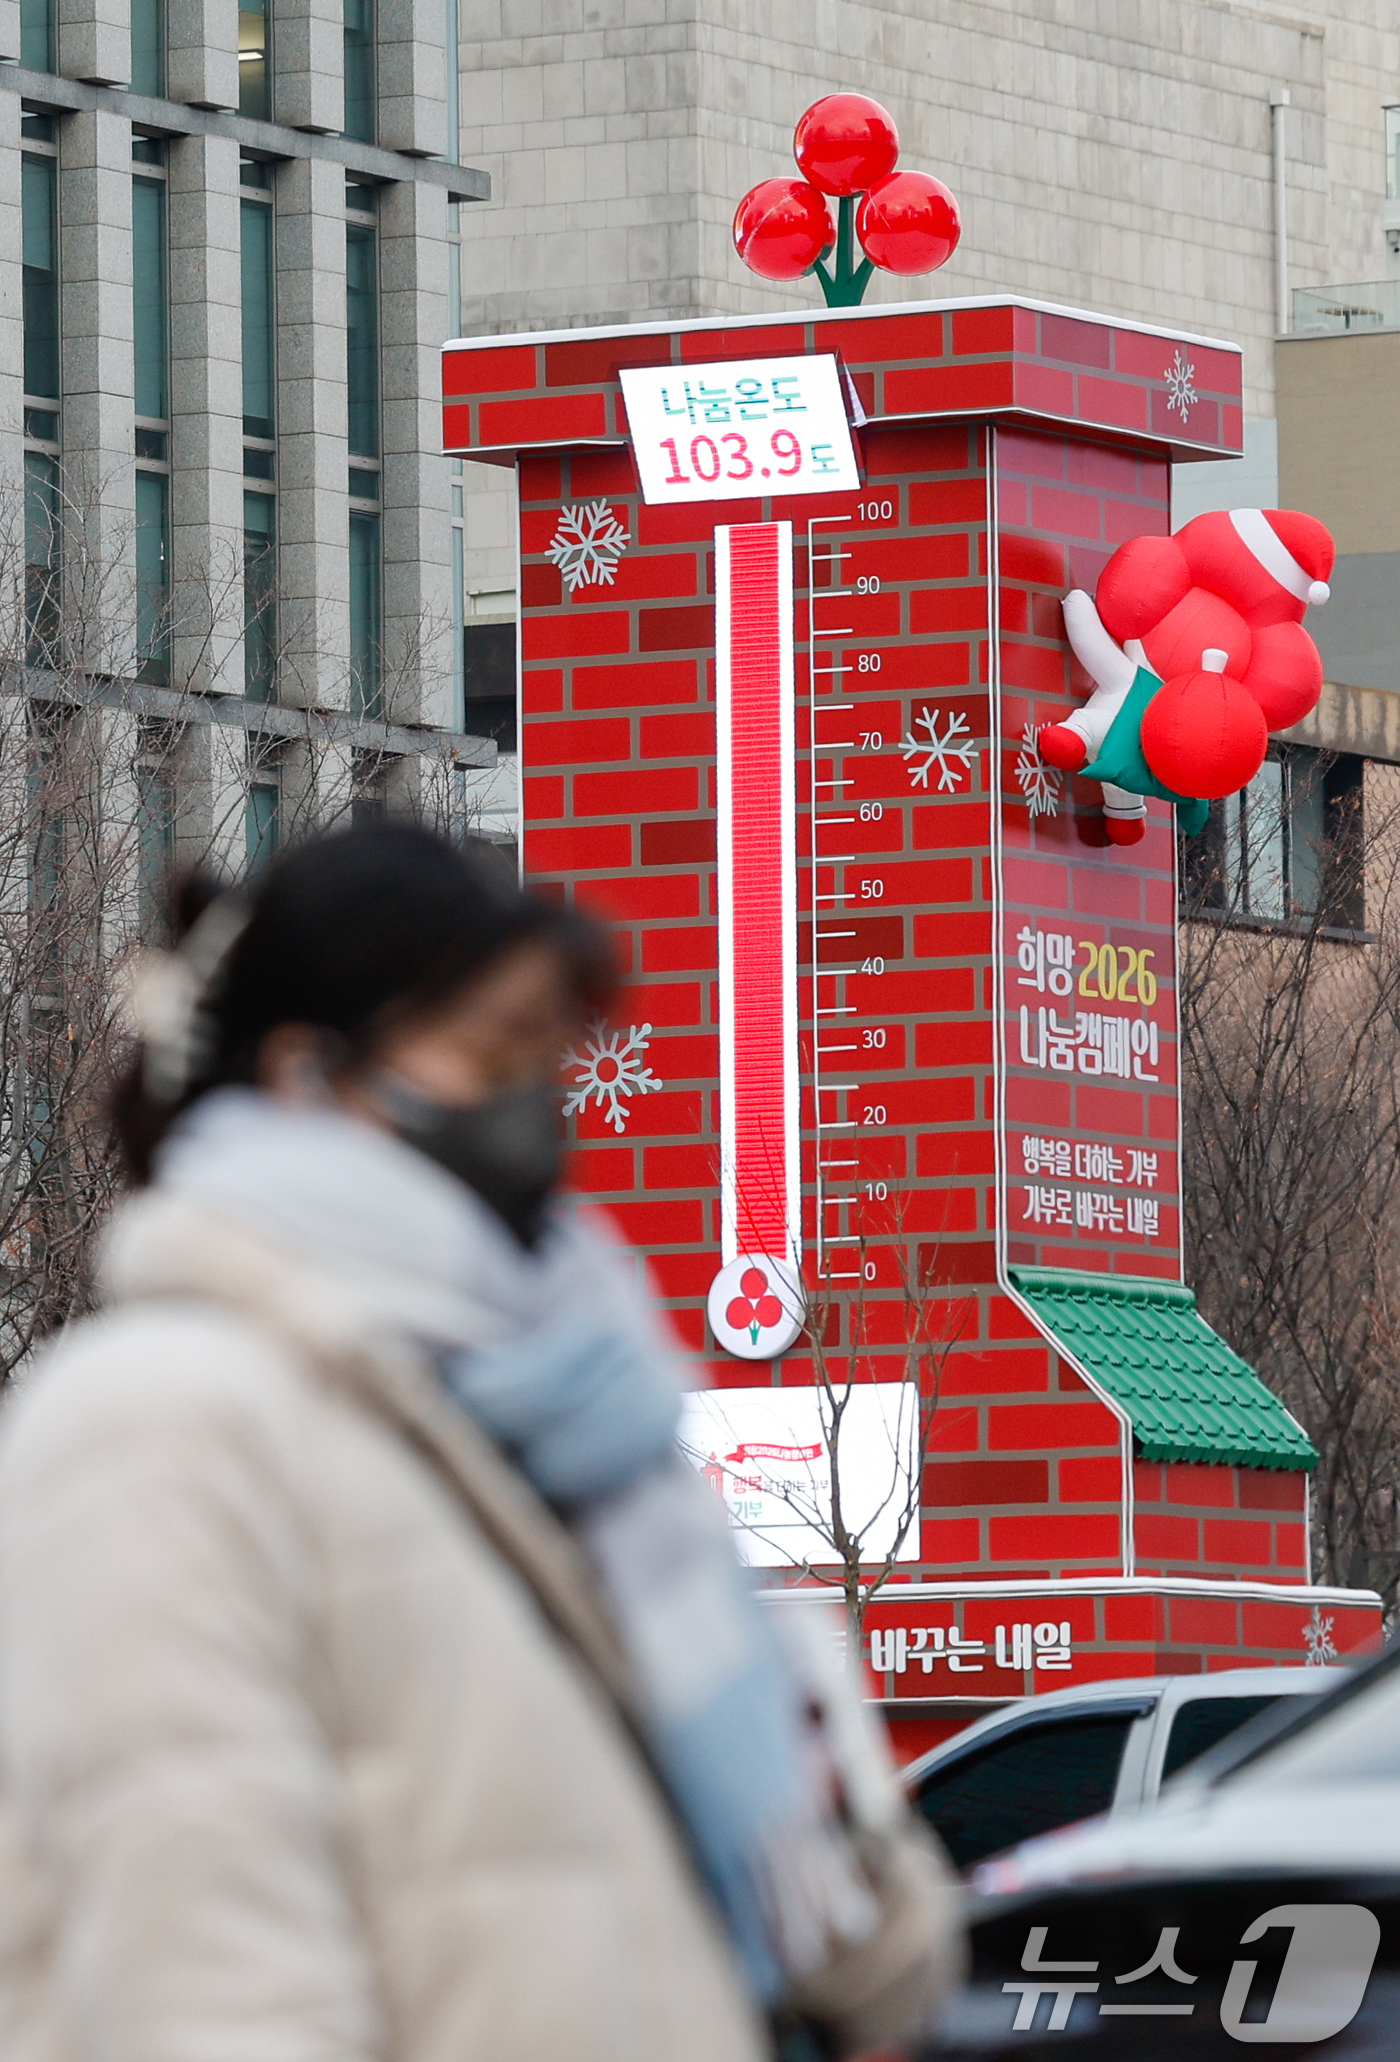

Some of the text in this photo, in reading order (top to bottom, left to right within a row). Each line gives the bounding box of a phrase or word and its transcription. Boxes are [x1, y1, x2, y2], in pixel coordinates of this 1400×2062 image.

[660, 376, 808, 425] 나눔온도
[857, 500, 892, 521] 100
[856, 575, 880, 595] 90
[858, 653, 881, 673] 80
[859, 731, 882, 751] 70
[859, 802, 883, 822] 60
[861, 879, 884, 899] 50
[860, 956, 885, 976] 40
[862, 1028, 886, 1049] 30
[1019, 1004, 1160, 1082] 나눔캠페인
[863, 1105, 887, 1125] 20
[1021, 1134, 1158, 1187] 행복을 더하는 기부
[865, 1181, 888, 1201] 10
[1022, 1184, 1159, 1236] 기부로 바꾸는 내일
[864, 1262, 876, 1281] 0
[733, 1501, 763, 1519] 기부
[870, 1627, 986, 1674] 바꾸는
[995, 1621, 1073, 1671] 내일
